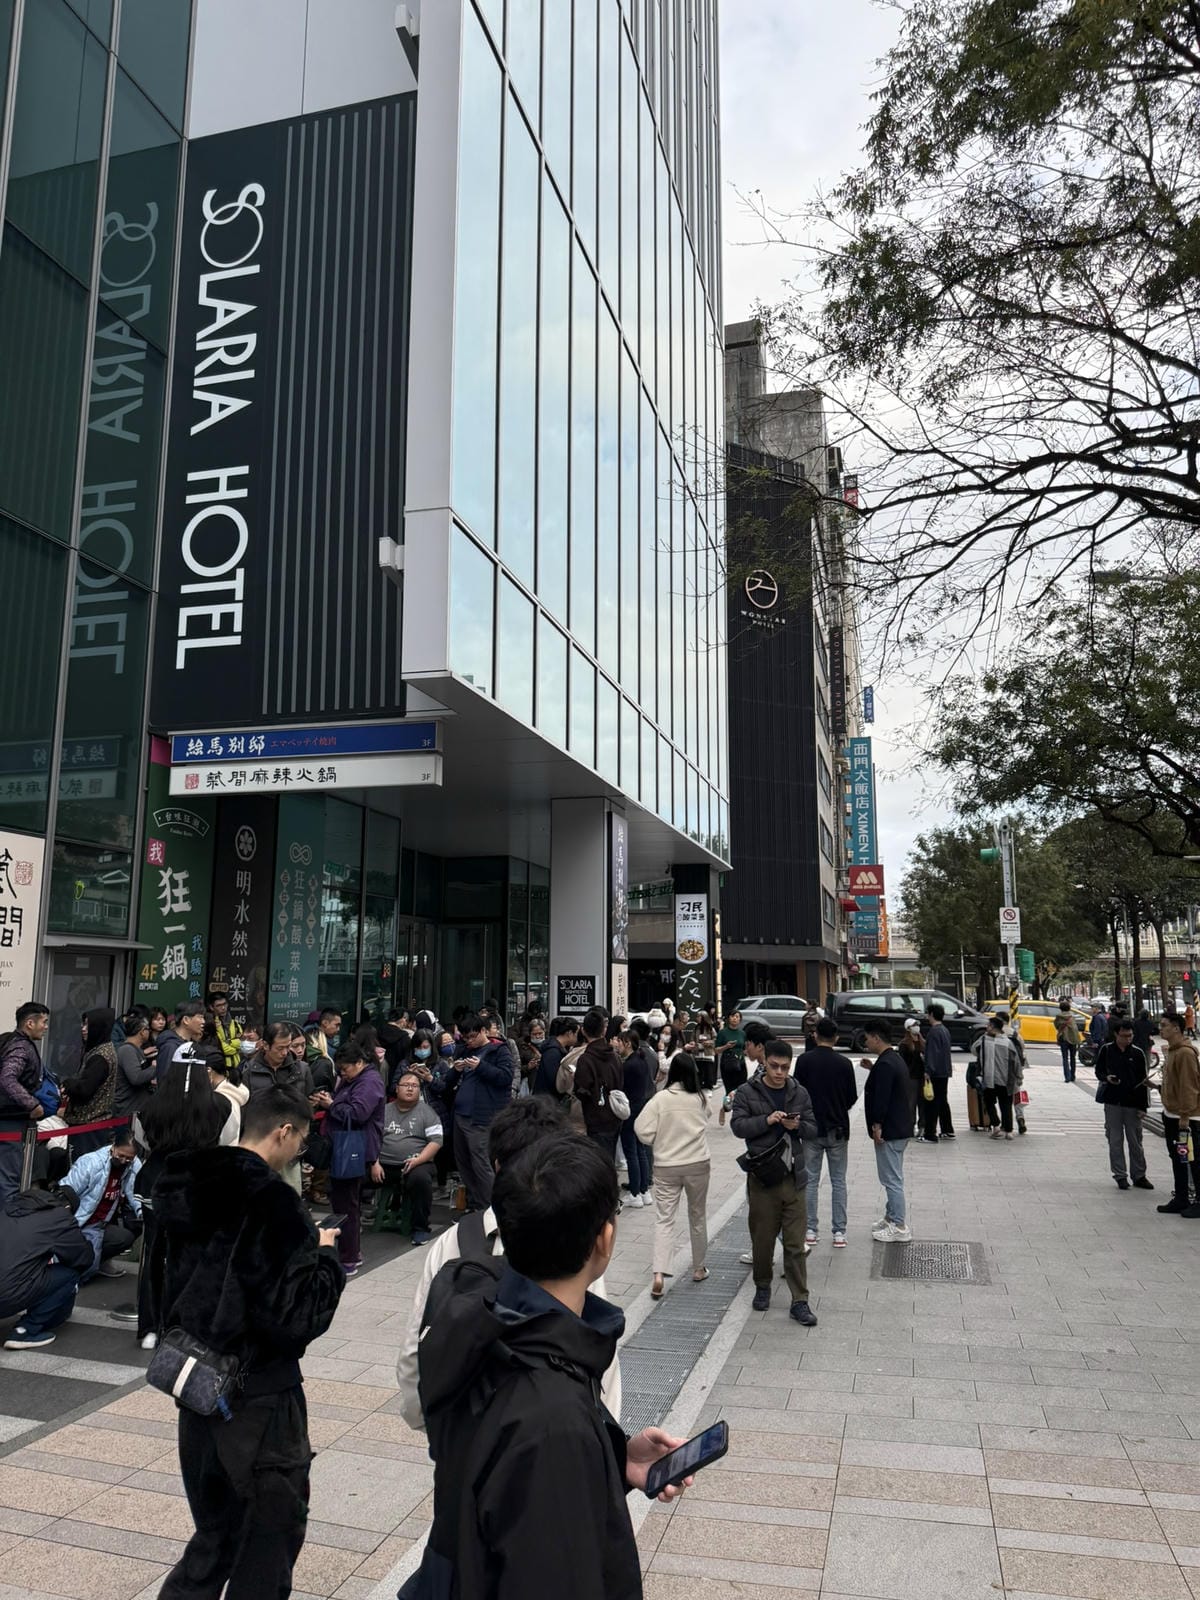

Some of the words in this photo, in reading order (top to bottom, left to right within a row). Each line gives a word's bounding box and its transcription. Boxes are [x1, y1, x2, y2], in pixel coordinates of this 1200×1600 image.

[190, 182, 266, 437] SOLARIA
[176, 465, 249, 670] HOTEL
[421, 739, 432, 747] 3F
[421, 773, 432, 781] 3F
[854, 743, 870, 809] 西門大飯店
[857, 812, 870, 853] XIMEN
[149, 841, 164, 864] 我
[157, 866, 192, 982] 狂一鍋
[141, 964, 158, 980] 4F
[189, 934, 203, 998] 我驕傲
[212, 967, 227, 981] 4F
[273, 968, 285, 981] 4F
[560, 979, 593, 990] SOLARIA
[565, 994, 590, 1005] HOTEL
